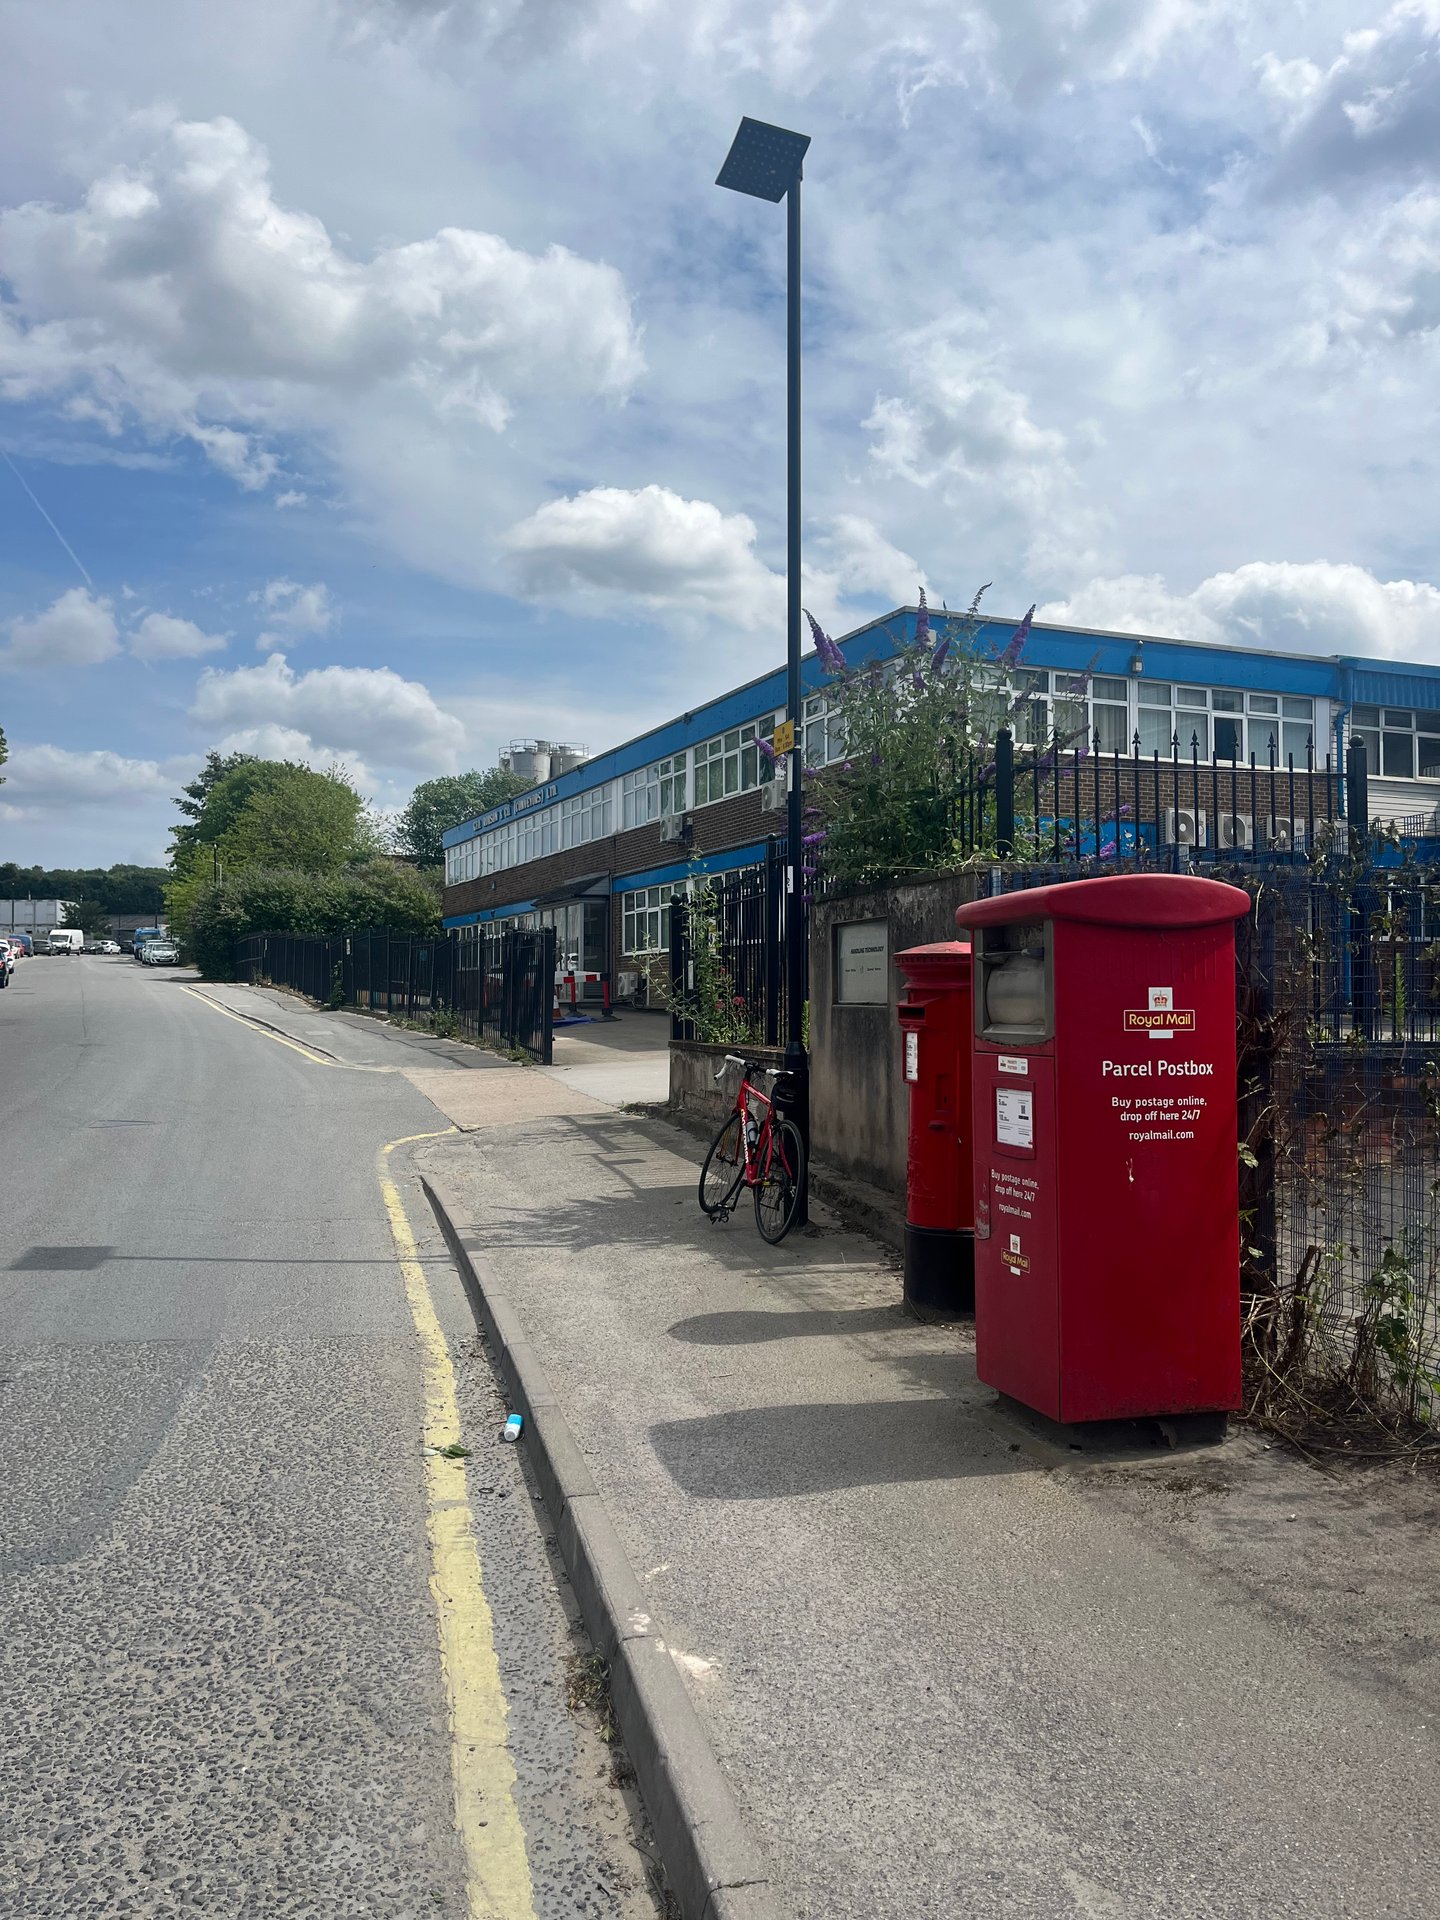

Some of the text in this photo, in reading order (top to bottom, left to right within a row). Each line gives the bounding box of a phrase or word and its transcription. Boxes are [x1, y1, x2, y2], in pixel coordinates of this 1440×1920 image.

[1129, 1014, 1190, 1027] Royal Mail
[1102, 1060, 1213, 1076] Parcel Postbox
[1112, 1096, 1207, 1108] Buy postage online,
[1120, 1110, 1200, 1122] drop off here 24/7
[1129, 1130, 1194, 1141] royalmail.com
[991, 1169, 1000, 1181] Buy
[1002, 1172, 1020, 1185] postage
[995, 1184, 1004, 1195] drop
[1013, 1188, 1023, 1199] here
[1024, 1190, 1035, 1202] 24/7
[999, 1203, 1031, 1219] royalmail.com
[1003, 1252, 1028, 1268] Royal Mail
